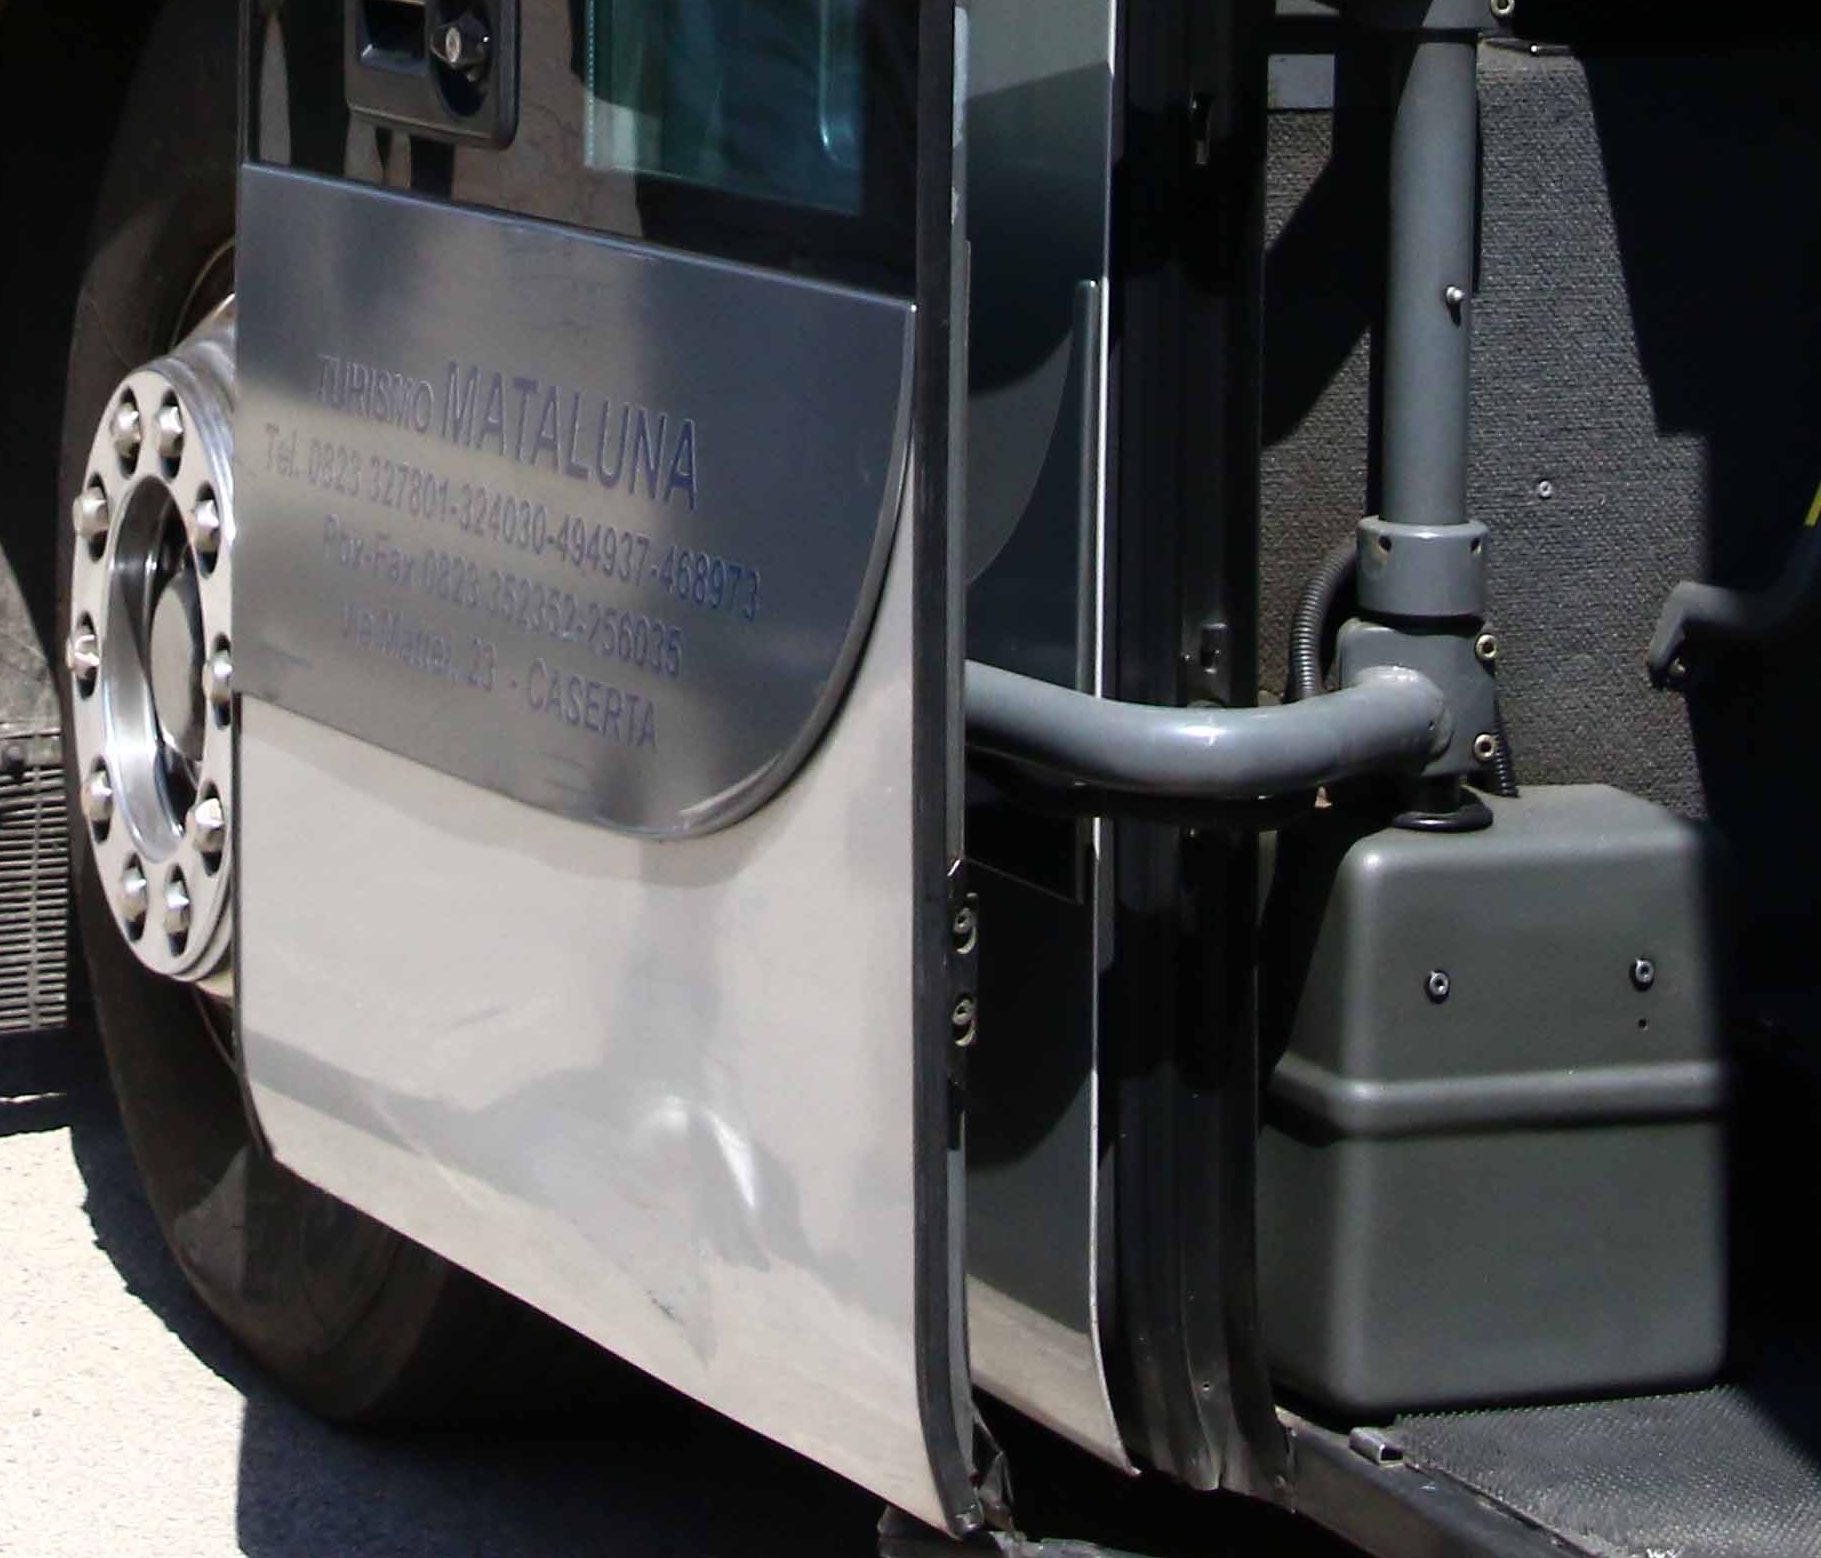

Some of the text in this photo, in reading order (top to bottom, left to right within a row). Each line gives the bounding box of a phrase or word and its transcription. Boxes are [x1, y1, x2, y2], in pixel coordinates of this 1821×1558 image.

[317, 353, 699, 511] TURISMO MATALUNA
[527, 657, 659, 748] CASERTA
